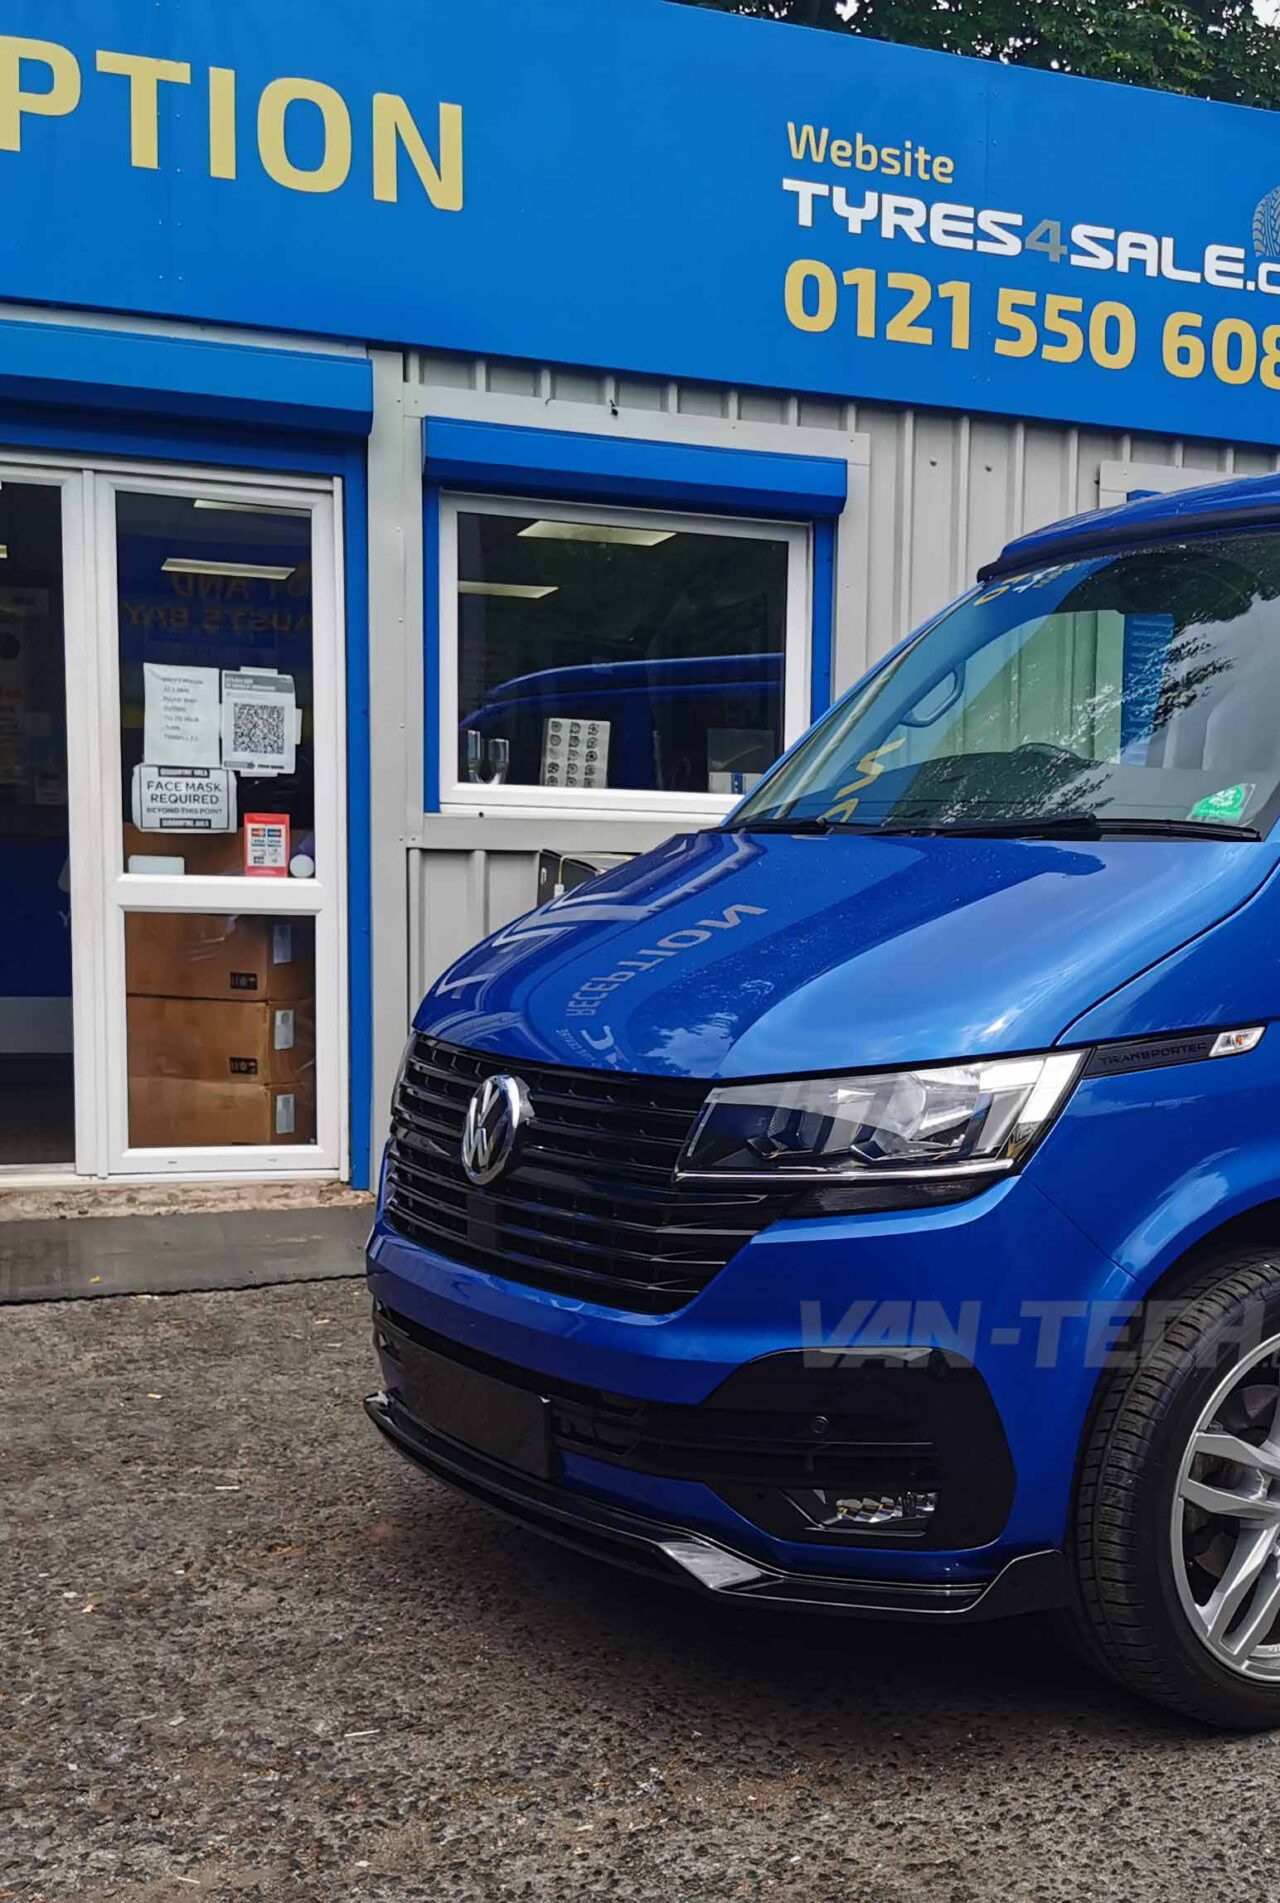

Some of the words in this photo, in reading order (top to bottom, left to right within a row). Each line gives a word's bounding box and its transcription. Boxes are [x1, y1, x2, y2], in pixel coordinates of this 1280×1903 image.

[787, 121, 954, 185] Website
[784, 259, 971, 350] 0121
[994, 287, 1136, 370] 550
[146, 780, 183, 792] FACE
[185, 781, 222, 793] MASK
[150, 793, 220, 805] REQUIRED
[1098, 1042, 1208, 1065] TRANSPORTER
